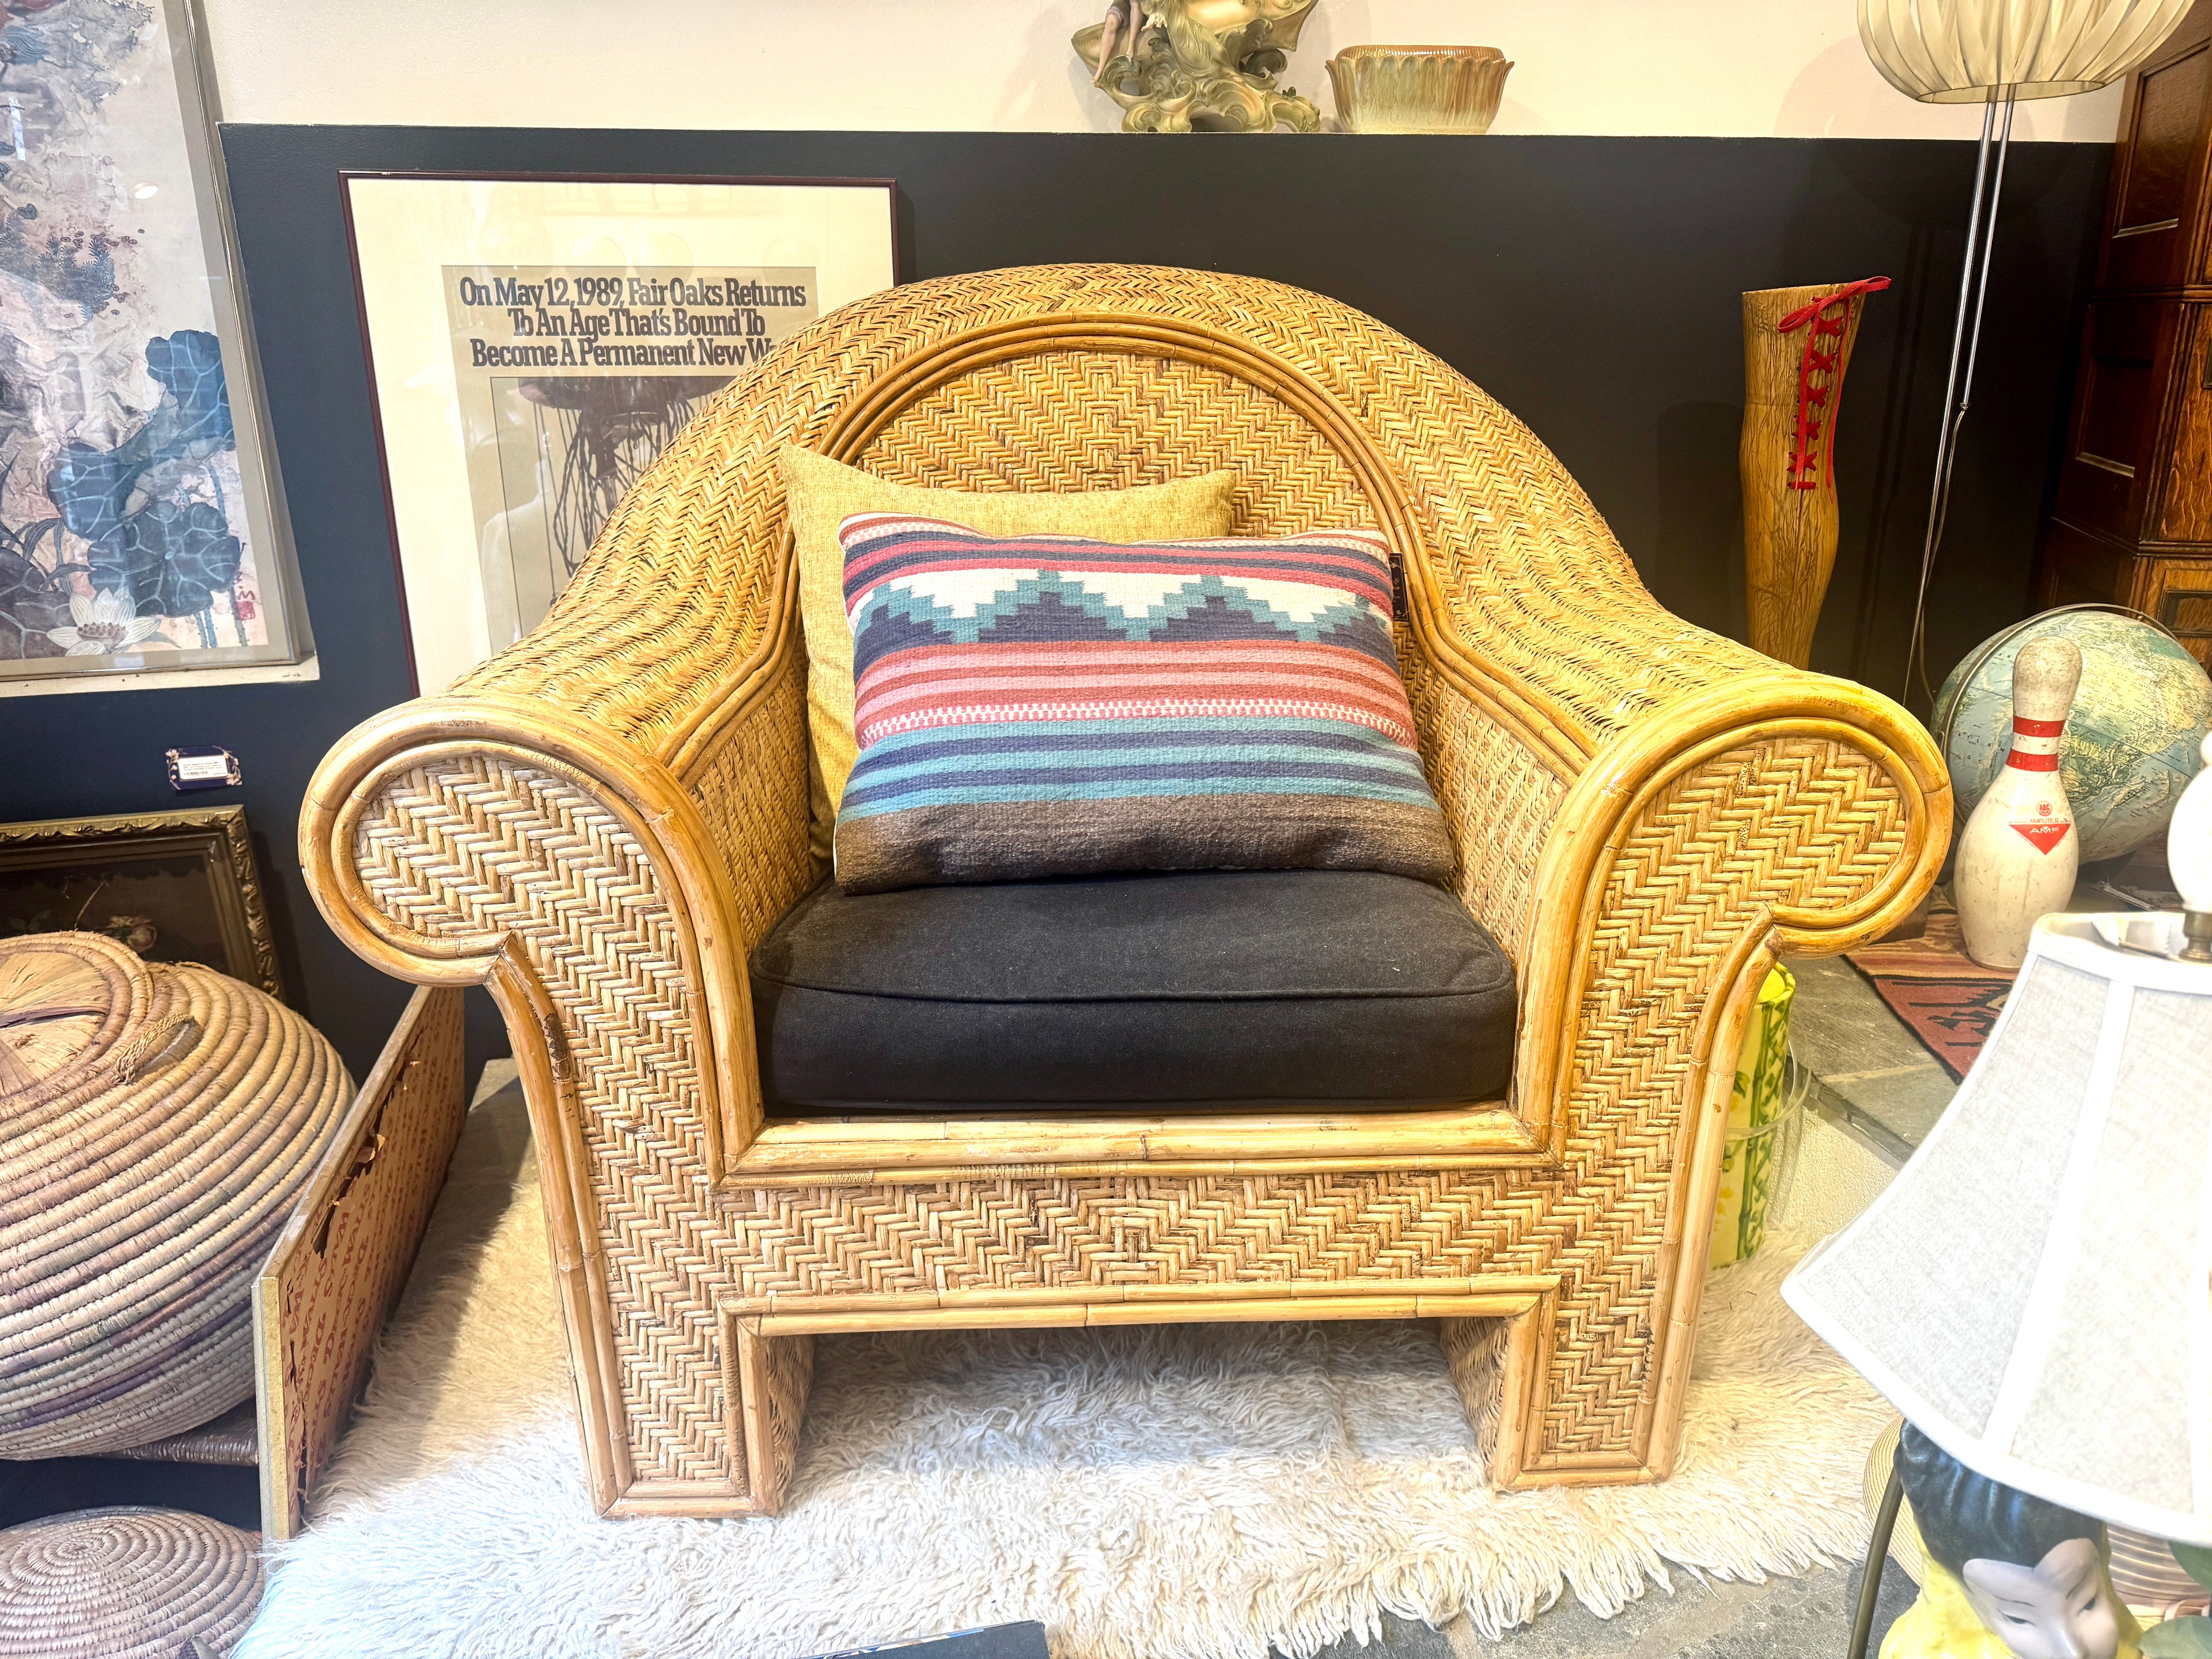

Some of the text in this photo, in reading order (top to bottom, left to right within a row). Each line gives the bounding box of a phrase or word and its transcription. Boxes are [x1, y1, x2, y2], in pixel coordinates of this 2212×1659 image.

[460, 276, 491, 306] On
[493, 277, 544, 312] May
[627, 278, 668, 306] Fair
[669, 277, 724, 306] Oaks
[724, 278, 806, 306] Returns
[507, 308, 766, 343] To An Age That's Bound To
[470, 338, 778, 366] Become A Permanent New W
